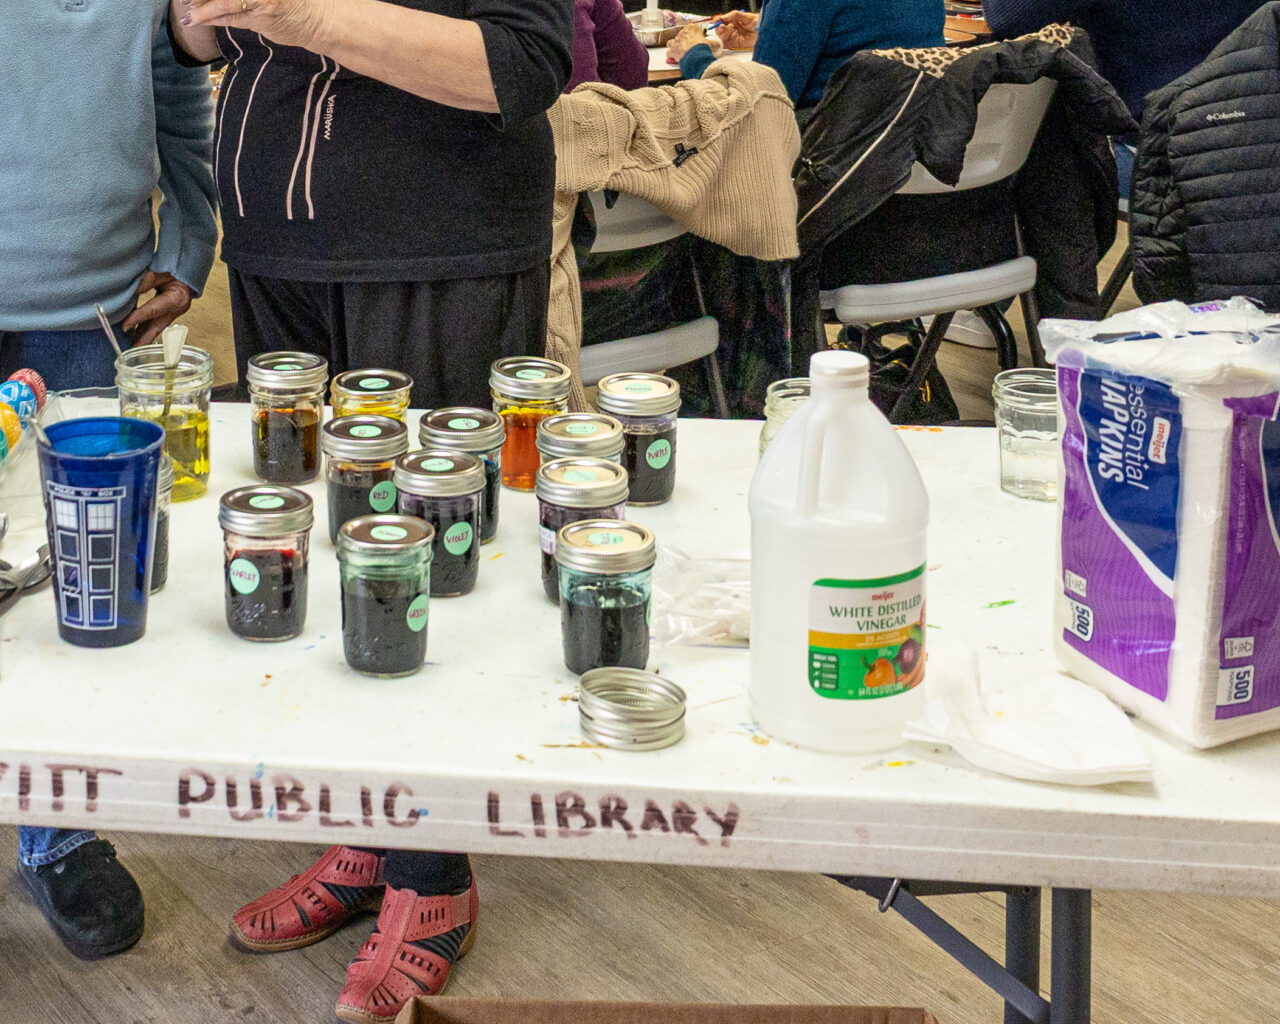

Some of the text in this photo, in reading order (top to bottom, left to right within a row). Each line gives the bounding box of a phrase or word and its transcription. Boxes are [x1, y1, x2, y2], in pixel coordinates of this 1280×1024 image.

[1213, 110, 1246, 121] Columbia
[1125, 382, 1149, 491] essential
[1153, 422, 1166, 459] meijer
[373, 490, 389, 500] RED
[446, 530, 469, 544] VIOLET
[829, 594, 922, 618] WHITE DISTILLED
[871, 591, 894, 601] meijer
[856, 615, 906, 631] VINEGAR
[1076, 605, 1090, 636] 500
[1233, 670, 1251, 700] 500
[176, 766, 422, 829] PUBLIC
[486, 790, 740, 847] LIBRARY
